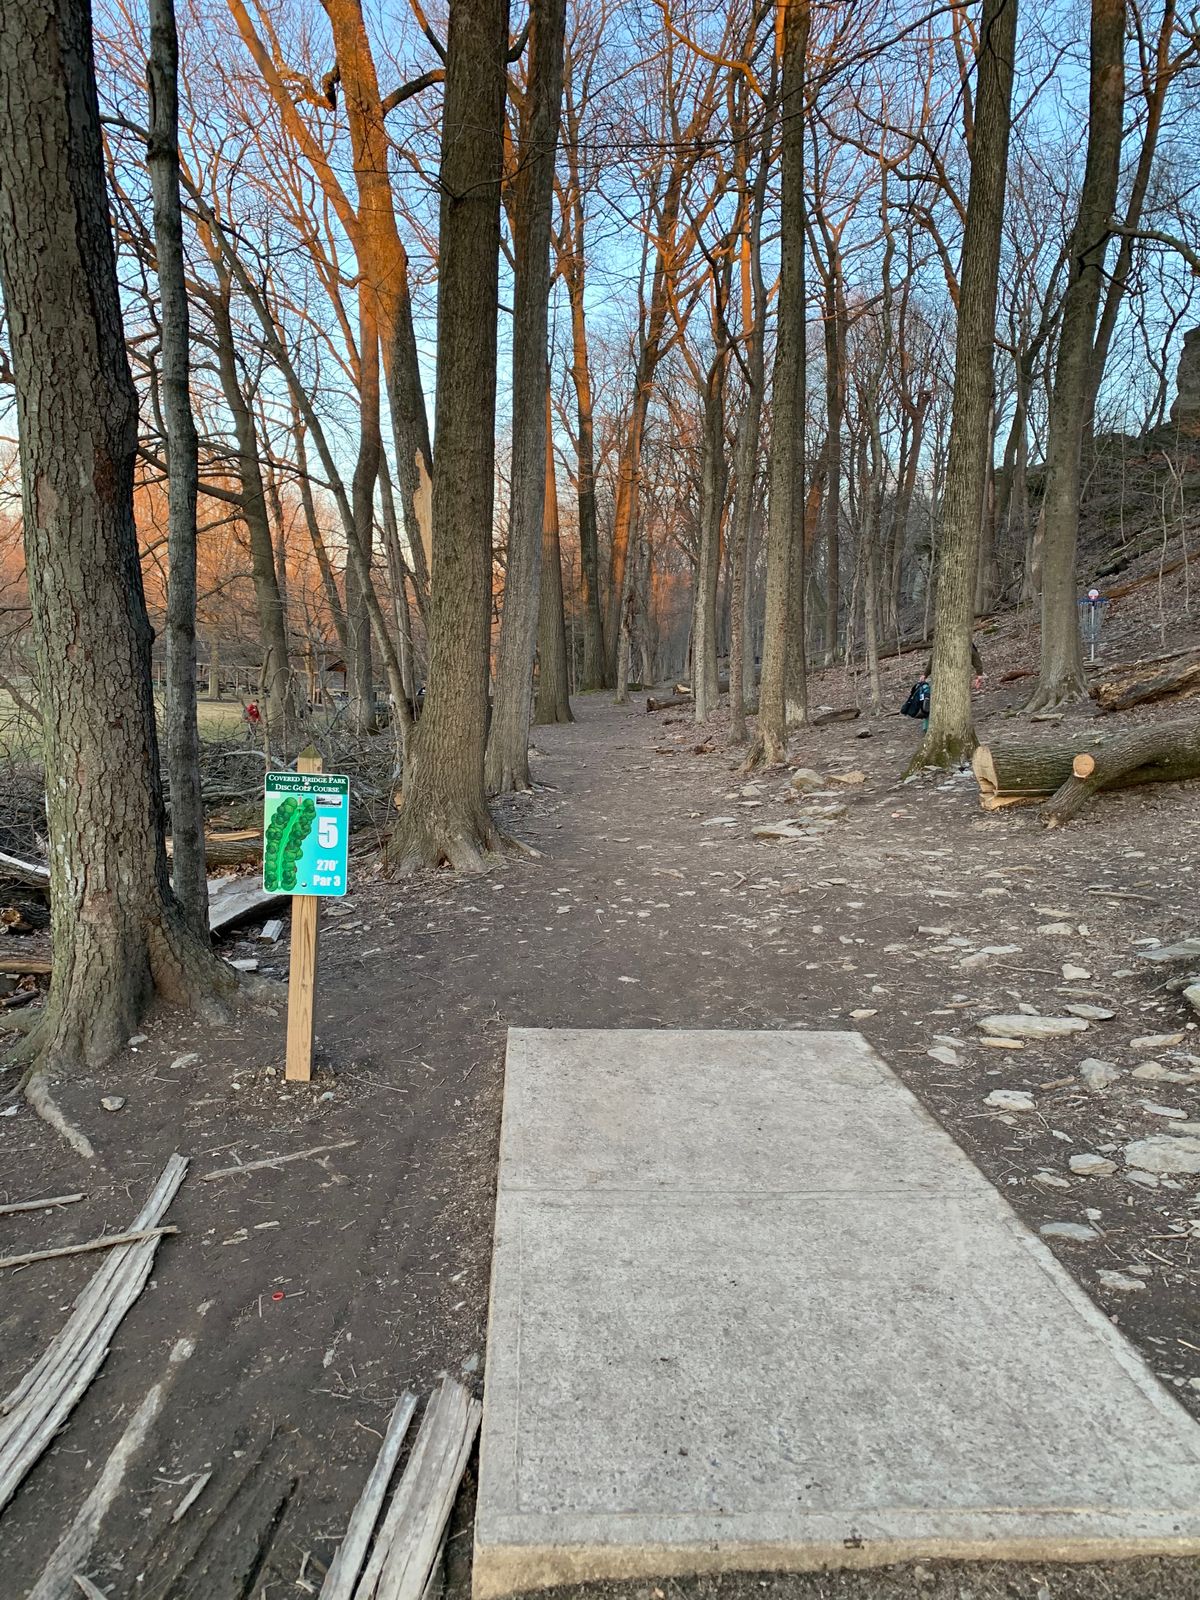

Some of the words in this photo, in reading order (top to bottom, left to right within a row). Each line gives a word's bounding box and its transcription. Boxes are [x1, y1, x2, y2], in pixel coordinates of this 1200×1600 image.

[268, 774, 301, 782] COVERED
[301, 775, 328, 784] BRIDGE
[275, 783, 292, 791] DISC
[292, 784, 312, 792] GOLF
[312, 785, 340, 793] COURSE
[318, 816, 339, 849] 5
[312, 874, 332, 886] Par
[333, 875, 341, 887] 3
